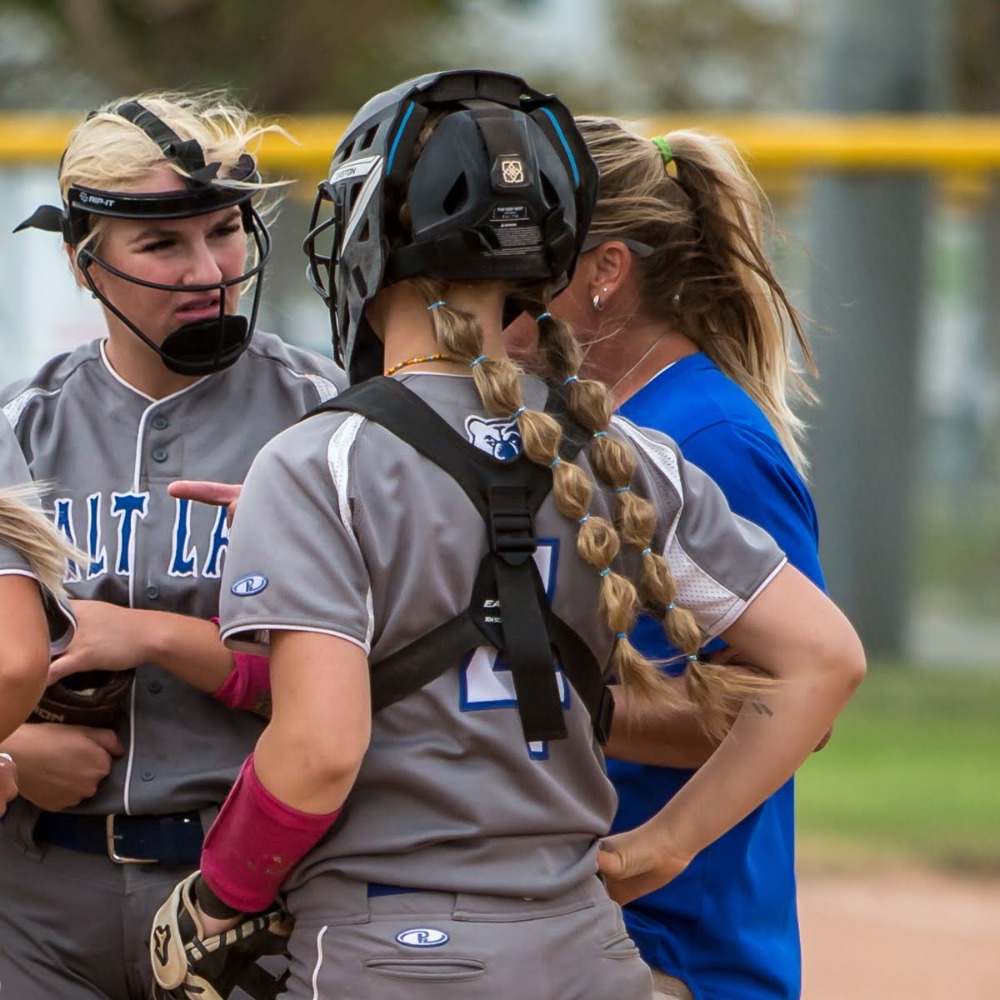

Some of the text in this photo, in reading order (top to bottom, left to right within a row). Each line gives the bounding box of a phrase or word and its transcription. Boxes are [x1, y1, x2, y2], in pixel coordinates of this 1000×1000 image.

[89, 195, 115, 207] RIP-IT
[54, 490, 230, 584] ALT LA
